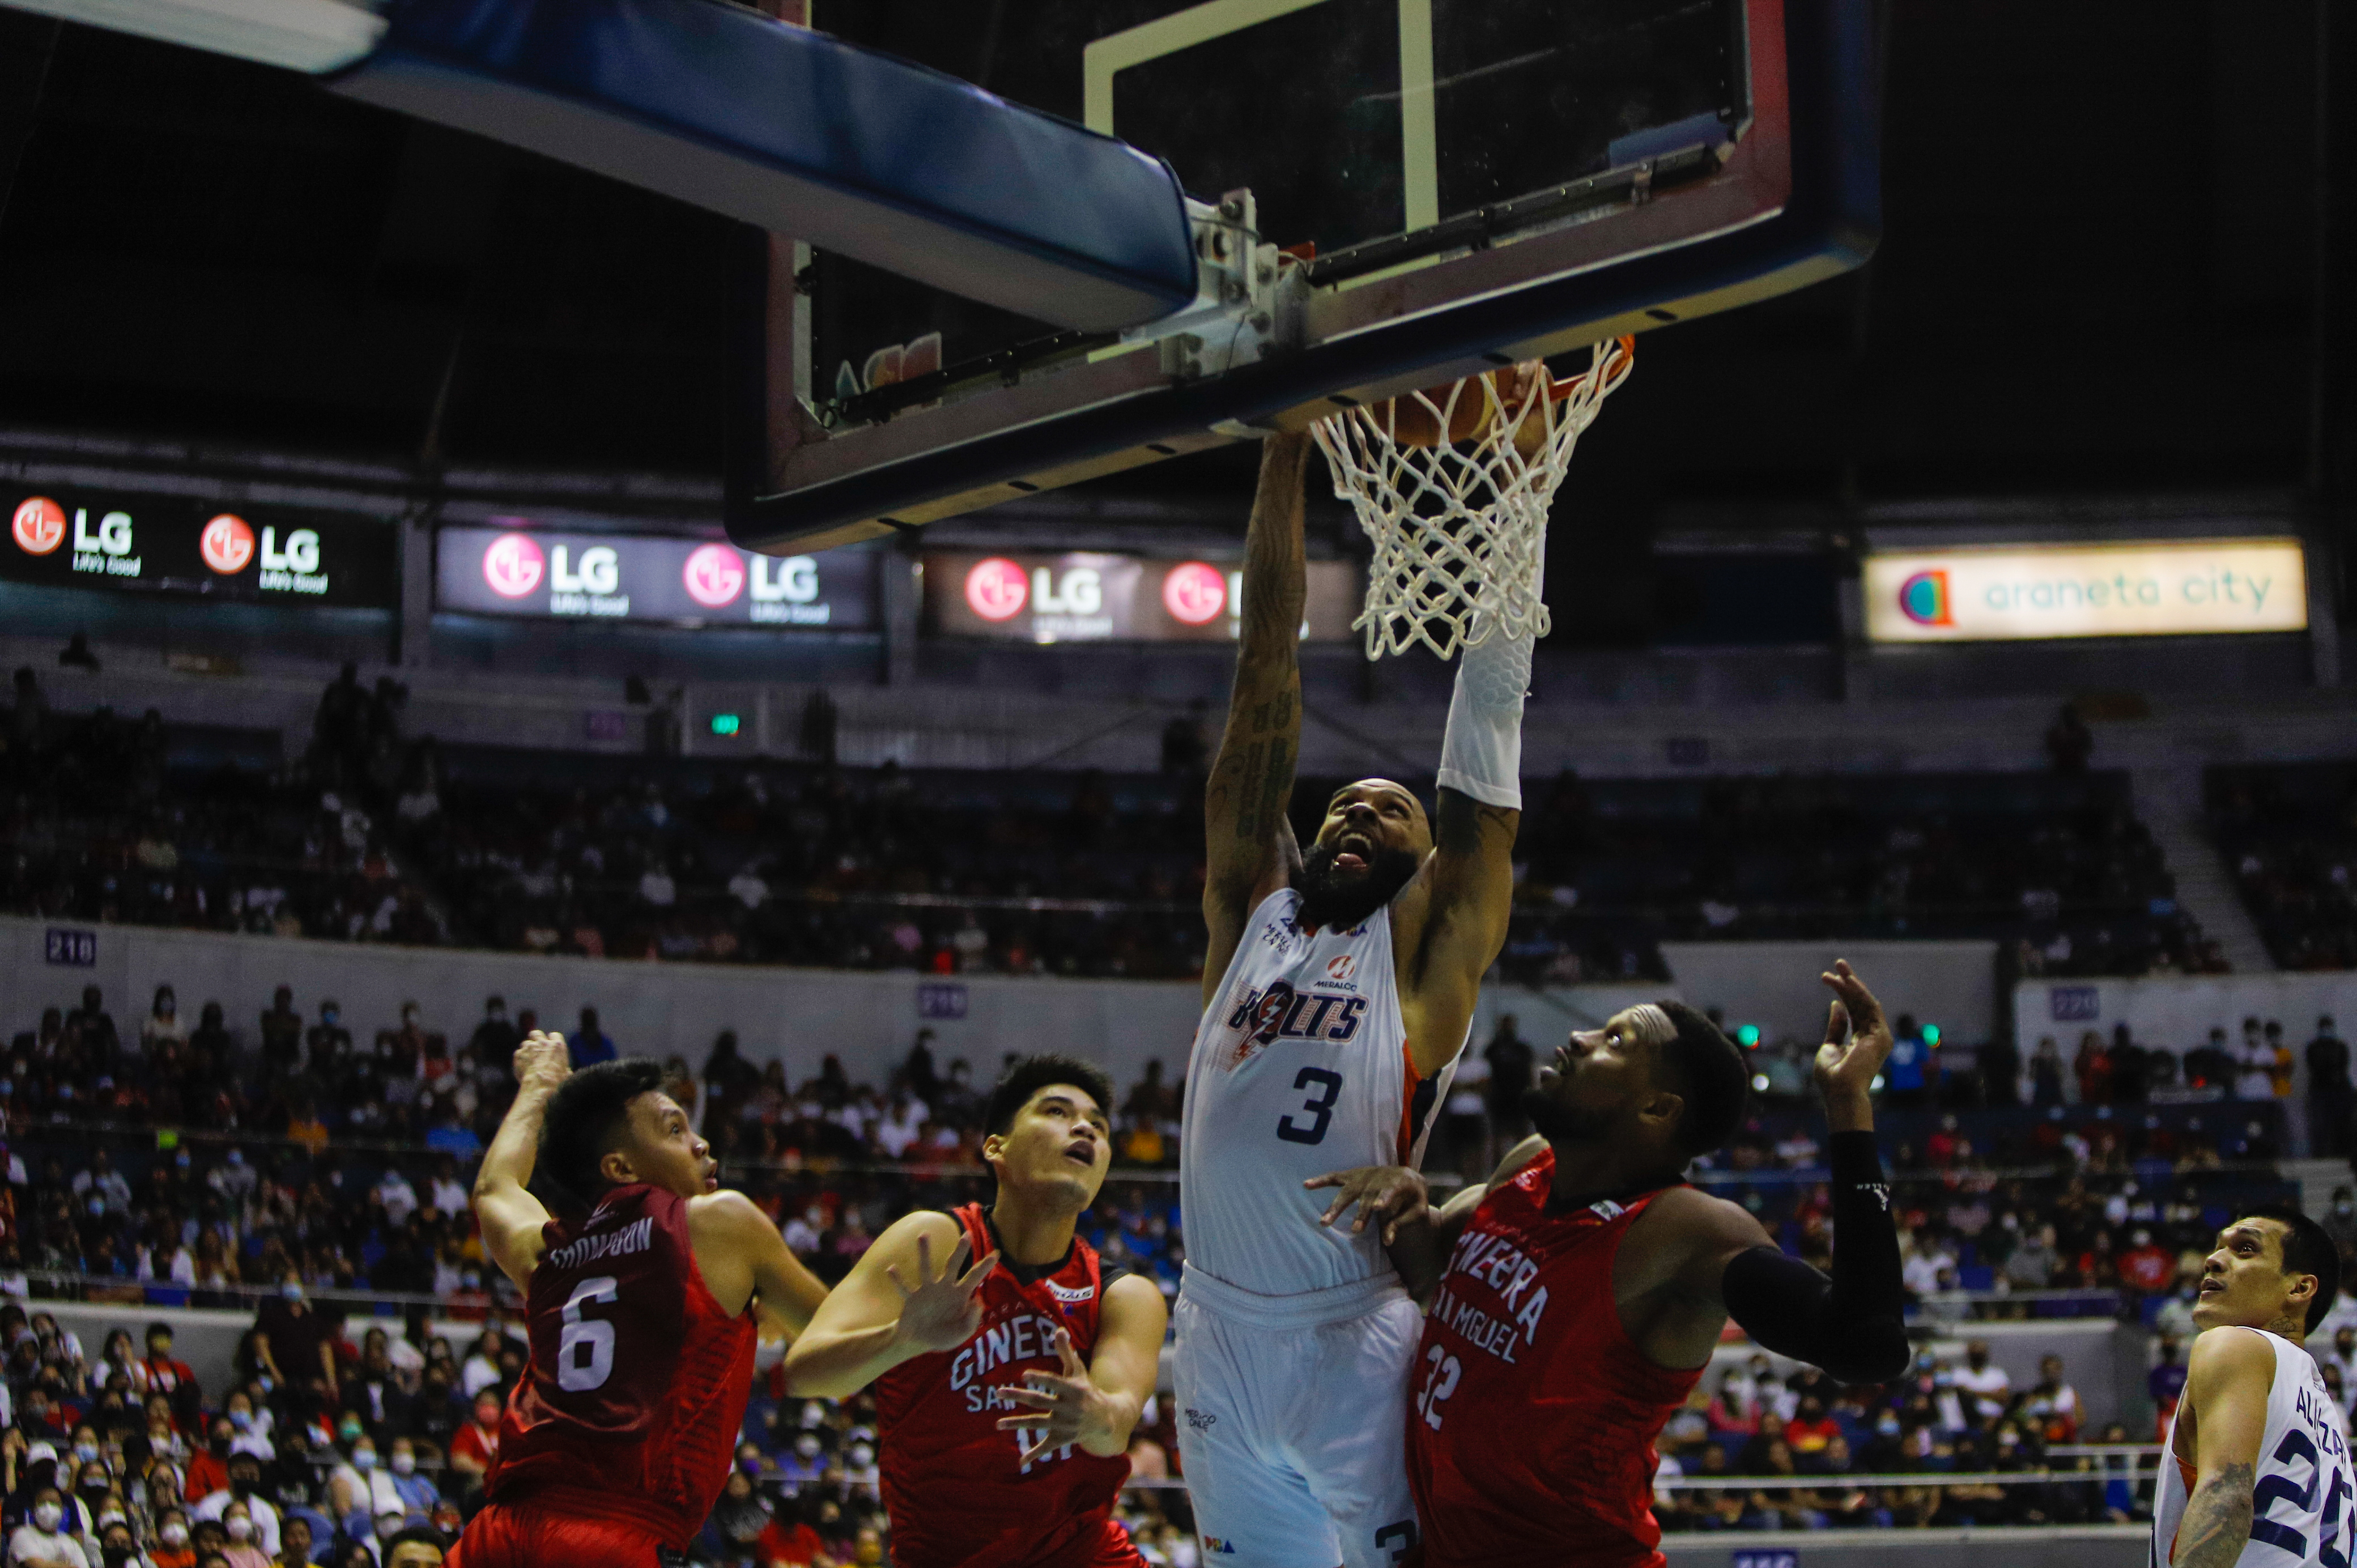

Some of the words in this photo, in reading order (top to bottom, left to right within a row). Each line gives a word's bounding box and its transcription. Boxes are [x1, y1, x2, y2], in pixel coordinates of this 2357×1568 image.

[74, 508, 133, 556] LG
[259, 525, 320, 573] LG
[551, 544, 619, 594] LG
[750, 553, 819, 603] LG
[1032, 566, 1102, 615] LG
[1985, 569, 2162, 611] araneta
[2182, 564, 2272, 613] city
[1314, 981, 1358, 991] MERALCO
[1277, 1067, 1343, 1145] 3
[558, 1276, 618, 1392] 6
[950, 1315, 1062, 1391] GINEB
